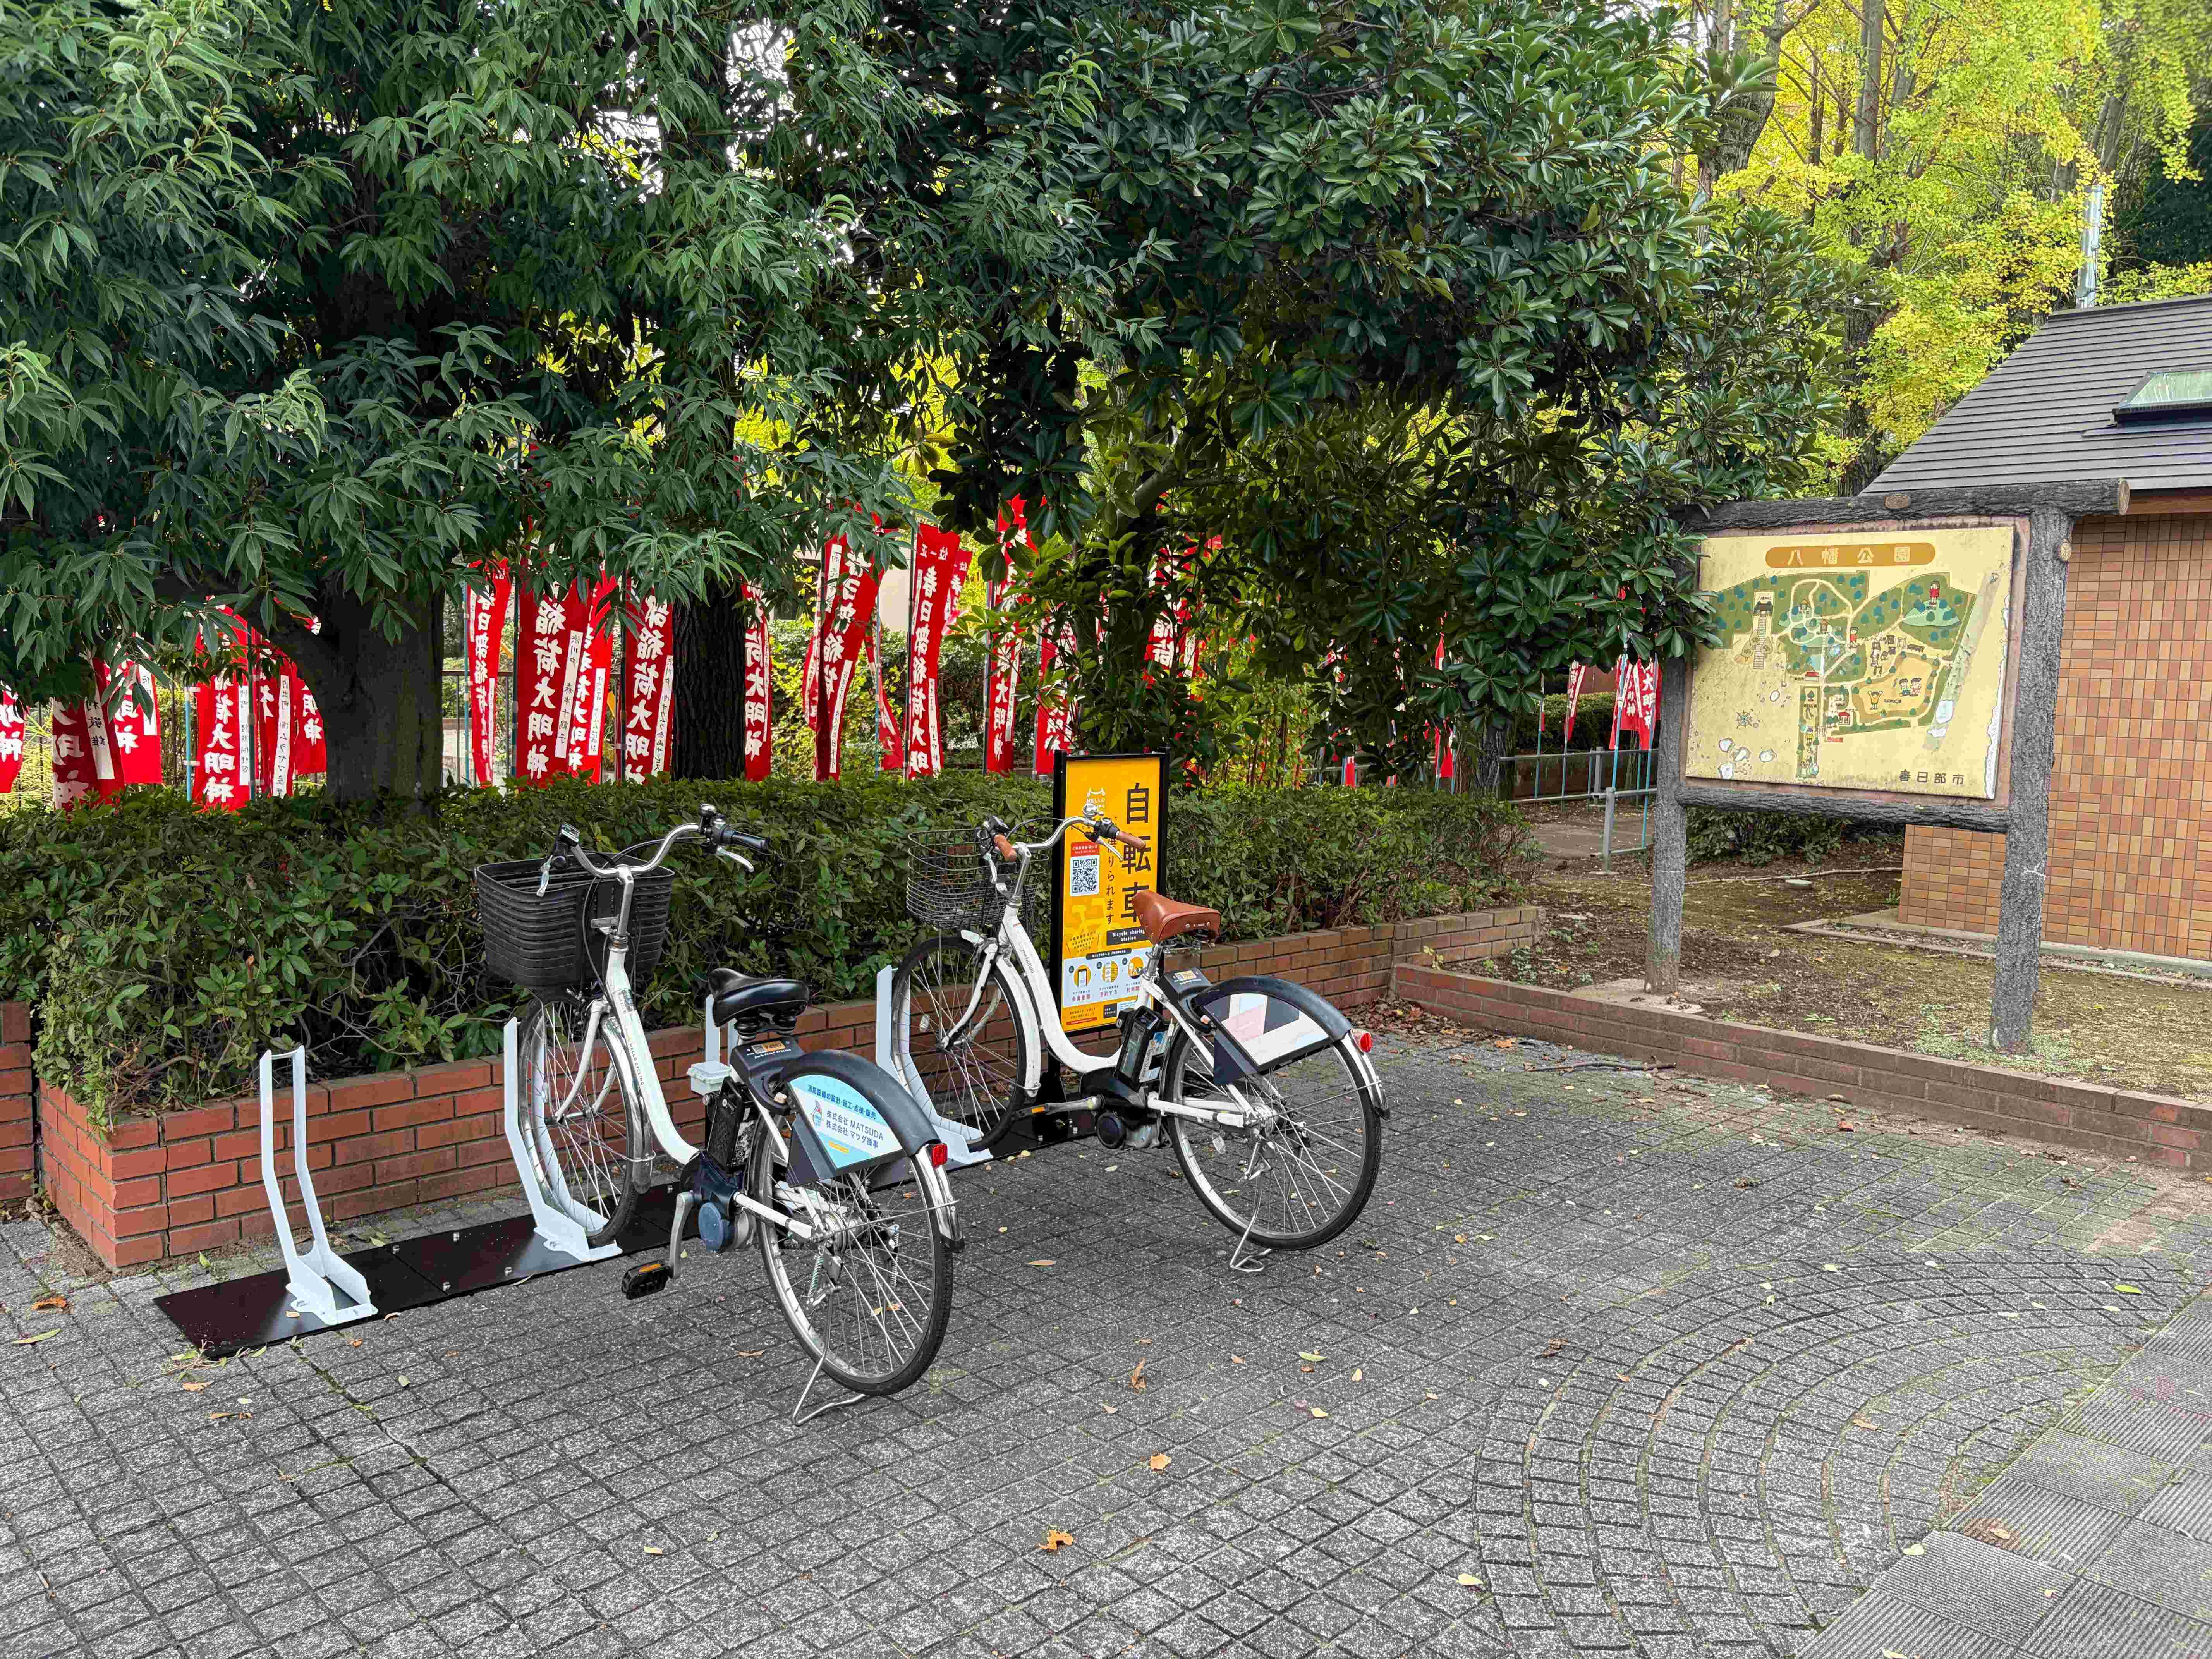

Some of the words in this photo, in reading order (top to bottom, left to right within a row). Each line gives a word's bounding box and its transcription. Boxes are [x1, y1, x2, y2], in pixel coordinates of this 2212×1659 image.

[1786, 545, 1911, 566] 八幡公園
[1899, 768, 1965, 786] 春日部市
[1121, 782, 1152, 923] 自転車
[826, 1120, 848, 1136] 株式会社
[827, 1109, 848, 1125] 株式会社
[850, 1120, 883, 1140] MATSUDA
